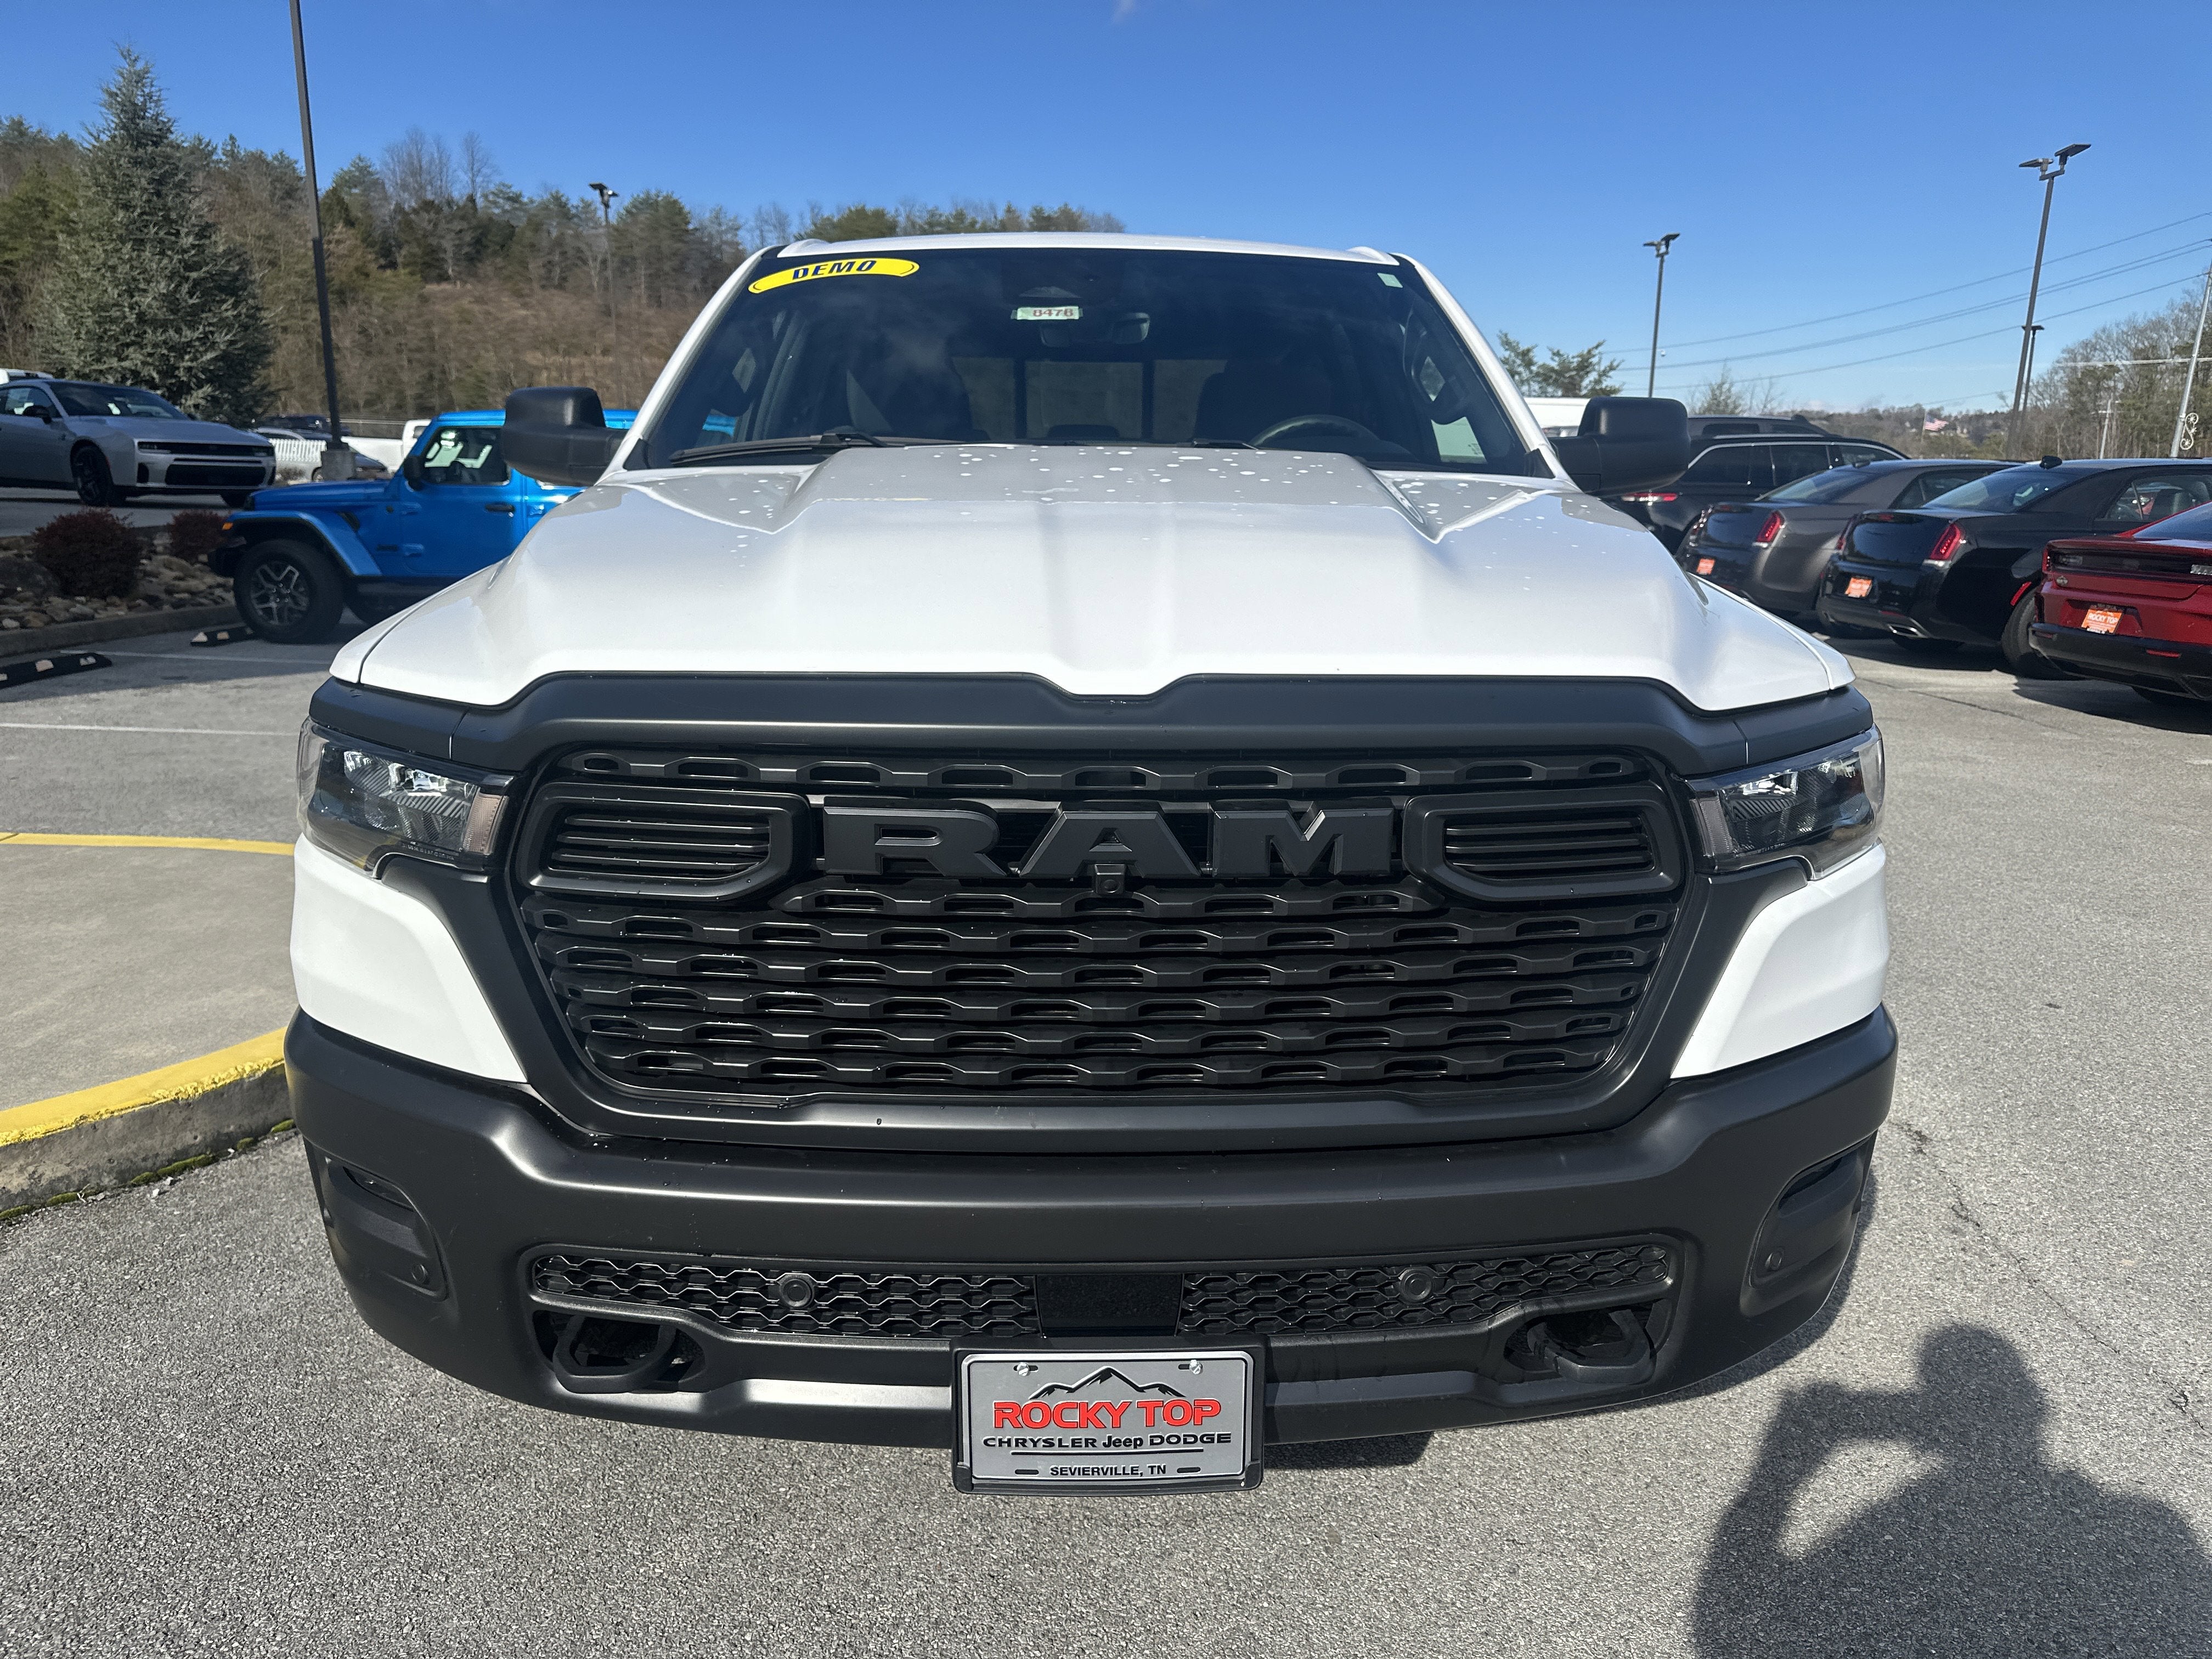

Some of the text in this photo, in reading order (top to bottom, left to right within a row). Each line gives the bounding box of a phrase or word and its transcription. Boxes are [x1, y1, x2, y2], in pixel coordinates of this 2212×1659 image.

[792, 260, 877, 280] DEMO
[822, 801, 1396, 878] RAM
[994, 1398, 1222, 1429] ROCKY TOP
[983, 1432, 1232, 1449] CHRYSLER Jeep DODGE
[1049, 1464, 1166, 1477] SEVIERVILLE, TN
